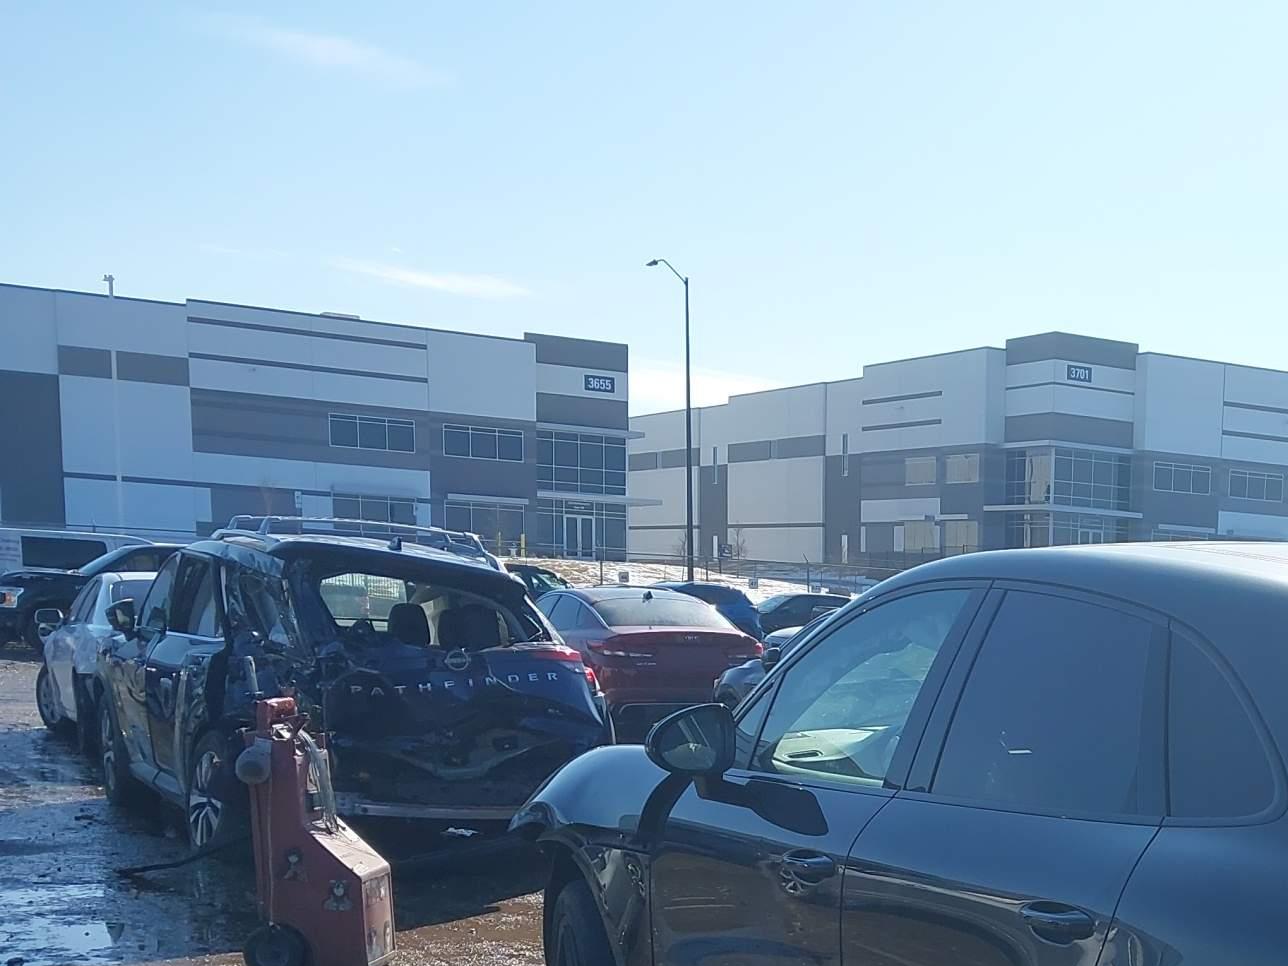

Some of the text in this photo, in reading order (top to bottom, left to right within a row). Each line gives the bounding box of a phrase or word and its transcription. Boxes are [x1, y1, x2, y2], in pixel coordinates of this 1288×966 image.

[1070, 368, 1089, 381] 3701
[588, 378, 612, 391] 3655
[350, 672, 559, 697] PATHFINDER
